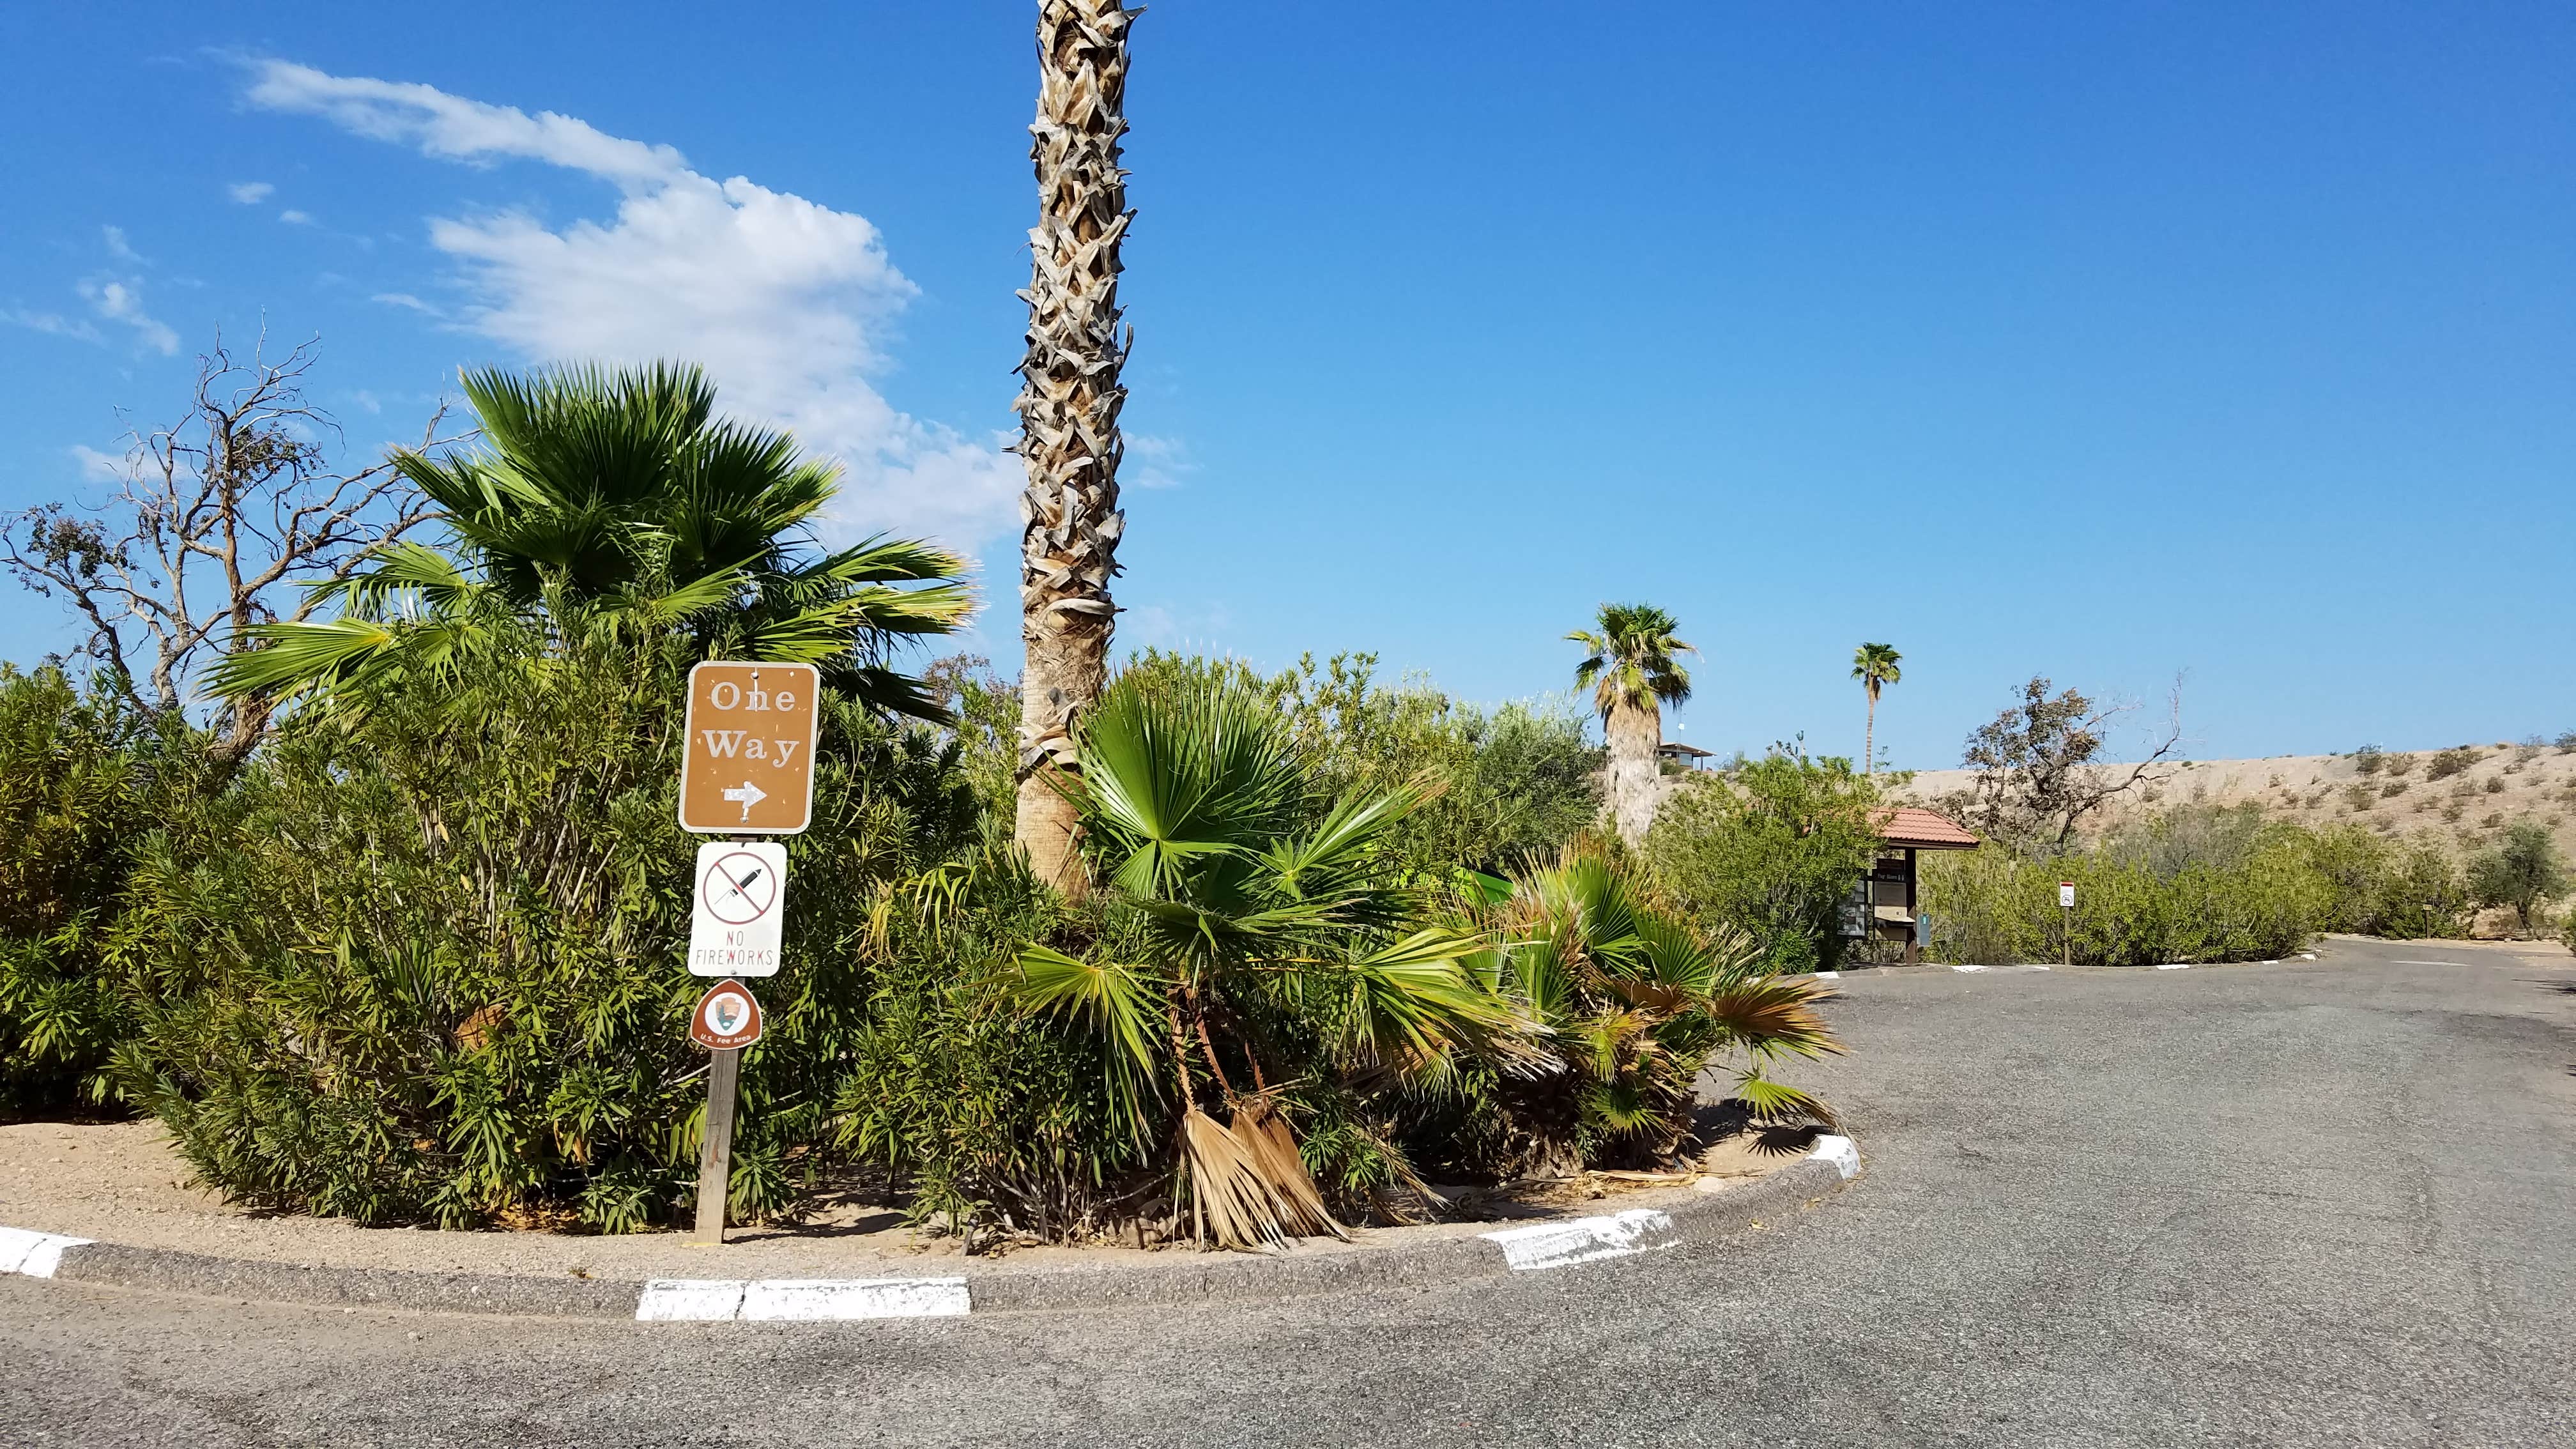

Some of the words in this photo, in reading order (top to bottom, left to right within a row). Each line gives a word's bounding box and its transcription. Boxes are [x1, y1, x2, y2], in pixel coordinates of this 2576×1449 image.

[710, 681, 795, 712] One
[702, 730, 799, 768] Way
[726, 930, 744, 946] NO
[695, 949, 773, 965] FIREWORKS
[700, 1032, 714, 1043] U.S.
[733, 1035, 751, 1043] Area
